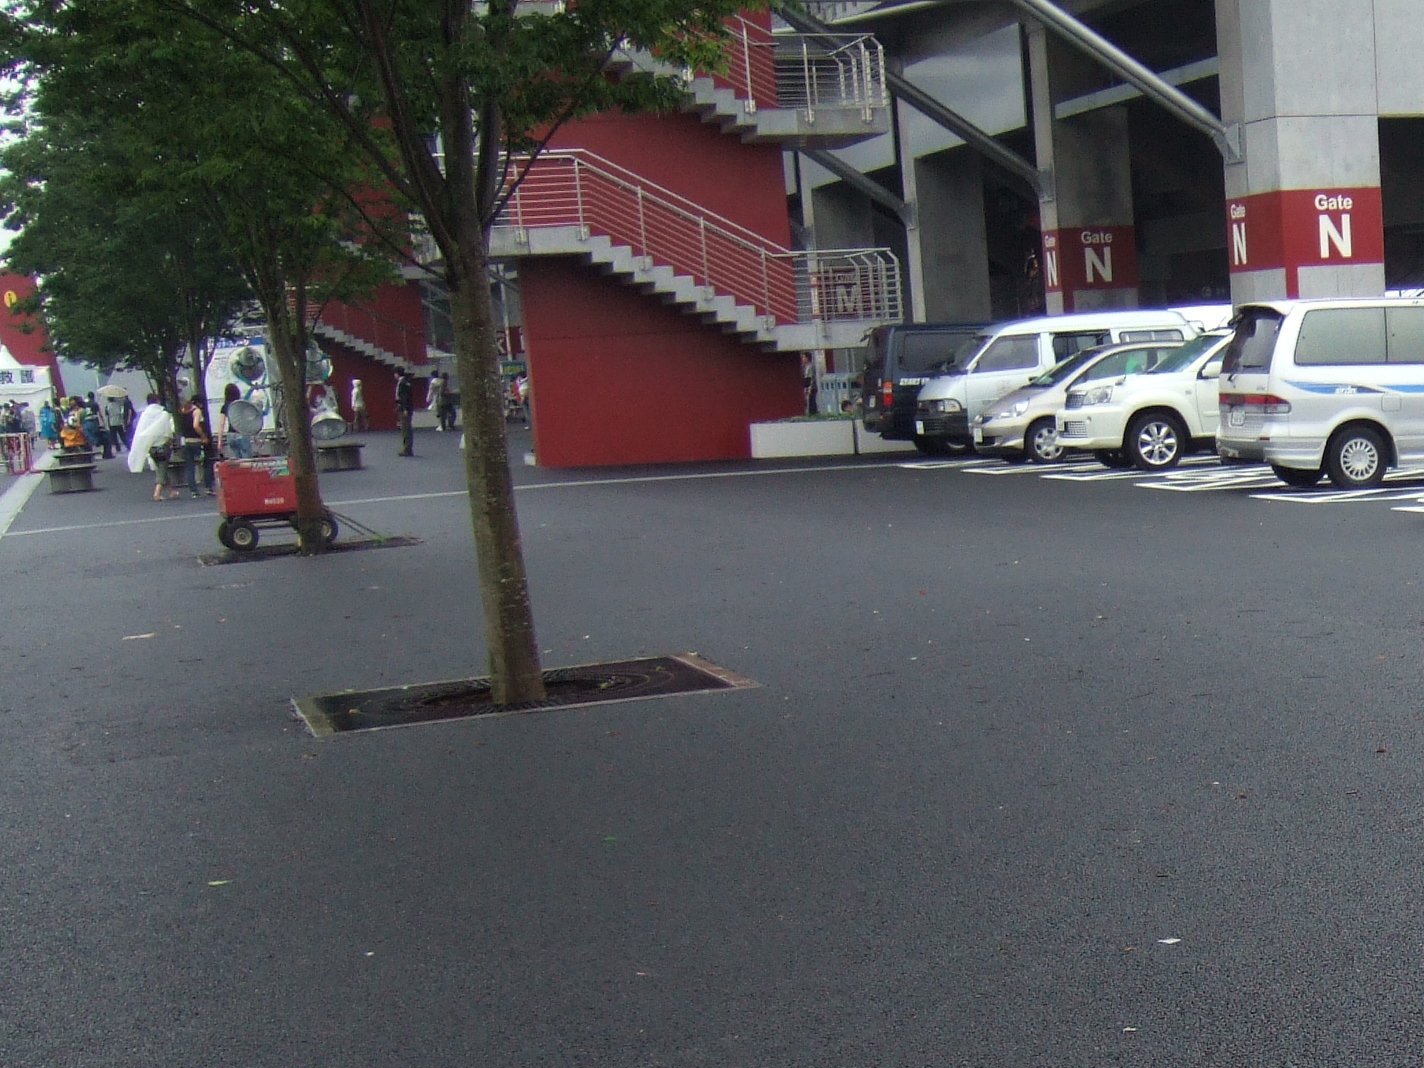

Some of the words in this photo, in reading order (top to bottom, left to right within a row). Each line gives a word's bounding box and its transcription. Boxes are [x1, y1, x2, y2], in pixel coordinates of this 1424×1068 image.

[1231, 203, 1246, 219] Gate
[1315, 194, 1353, 211] Gate
[1081, 231, 1113, 244] Gate
[1232, 222, 1247, 266] N
[1319, 213, 1353, 258] N
[1046, 251, 1058, 287] N
[1084, 246, 1113, 283] N
